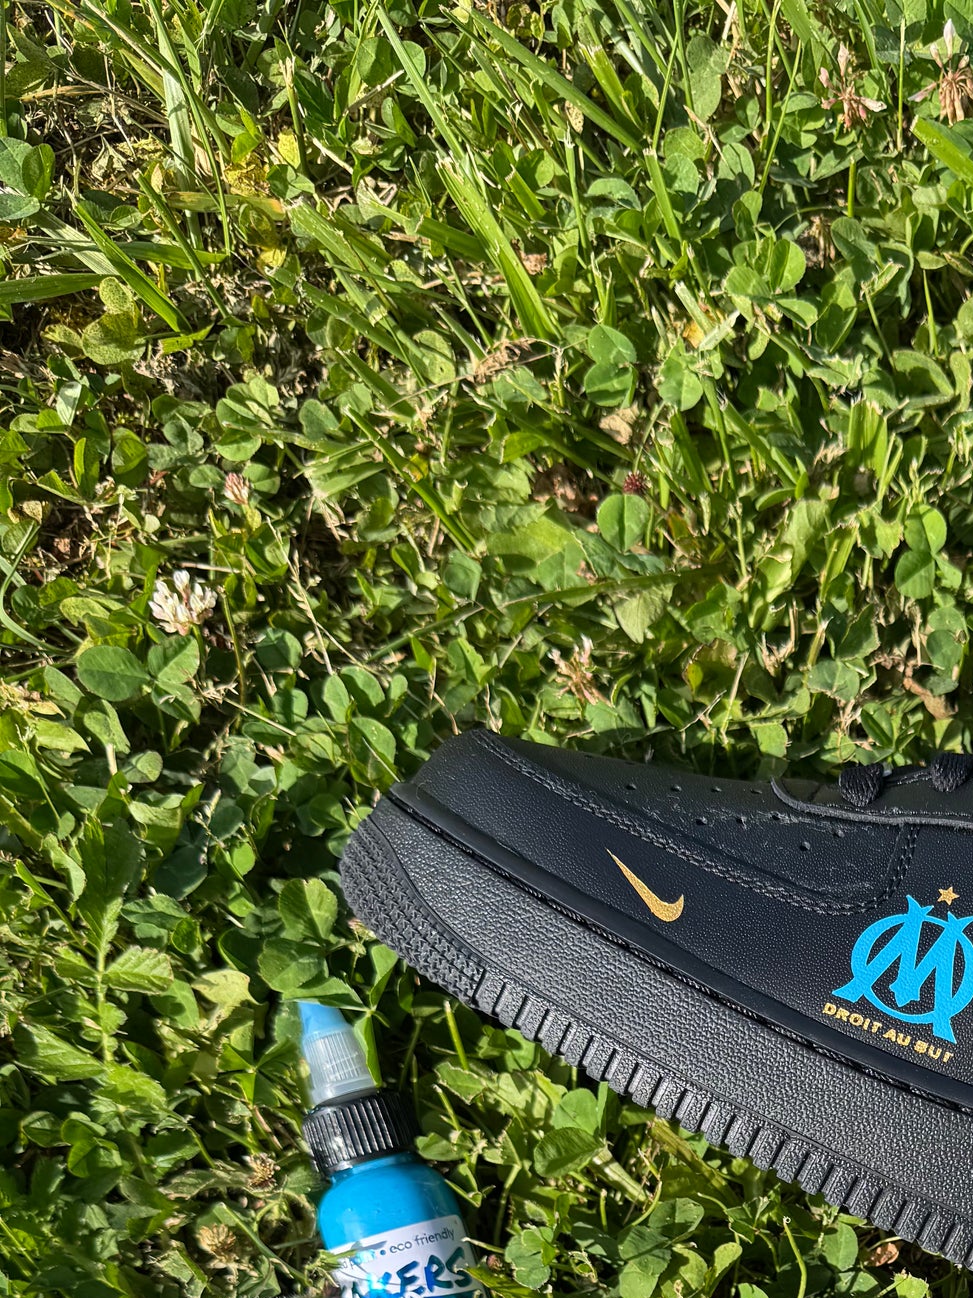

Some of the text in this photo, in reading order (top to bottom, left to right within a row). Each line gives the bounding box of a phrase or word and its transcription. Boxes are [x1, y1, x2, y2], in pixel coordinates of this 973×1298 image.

[821, 1001, 956, 1063] DROIT AU BUT
[389, 1228, 456, 1254] eco friendly
